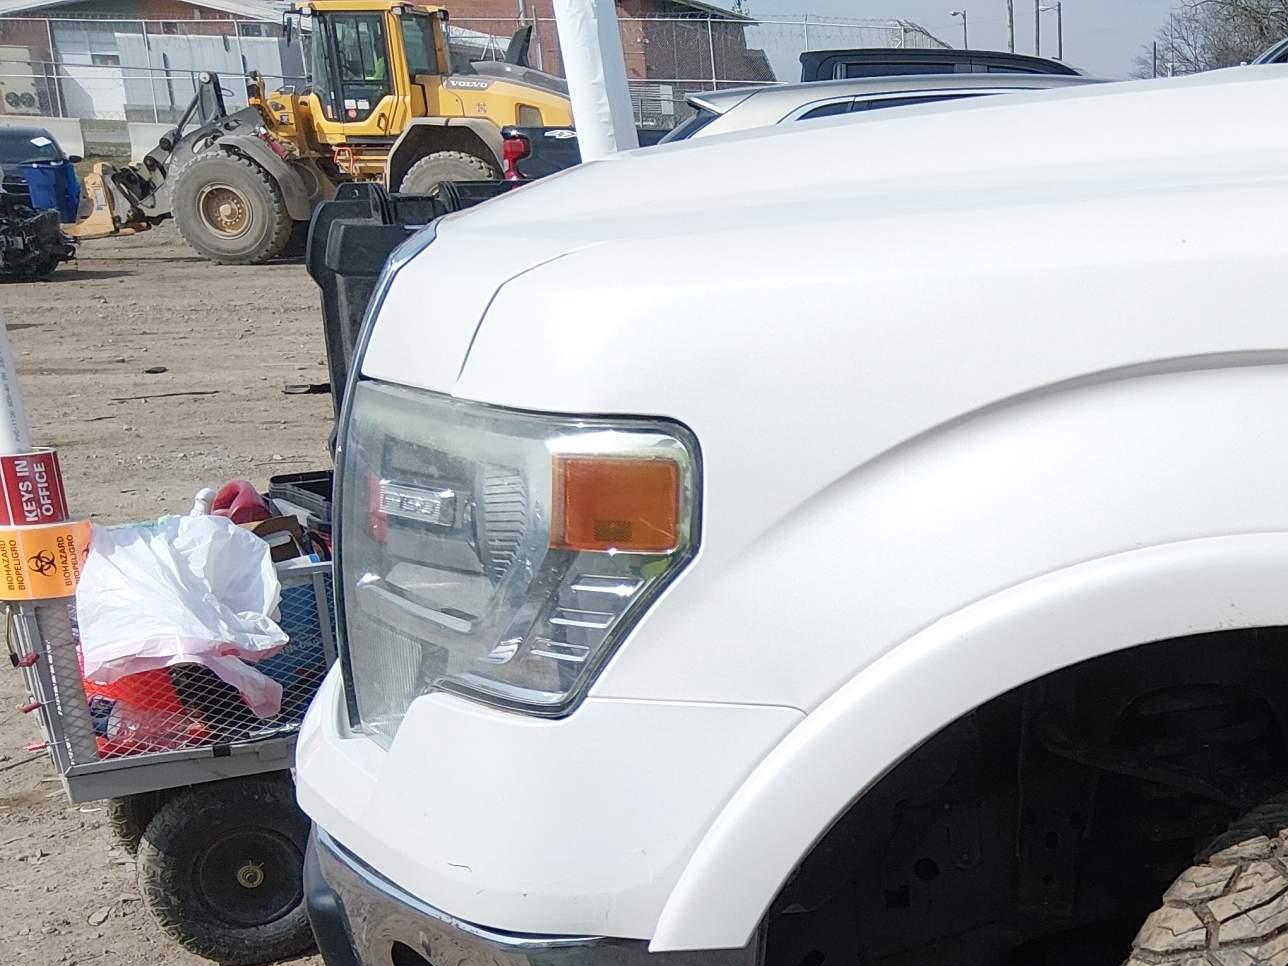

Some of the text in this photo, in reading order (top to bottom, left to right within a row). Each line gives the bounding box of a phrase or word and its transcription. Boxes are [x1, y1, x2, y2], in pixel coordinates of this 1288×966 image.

[450, 80, 488, 88] VOLVO
[14, 460, 39, 522] KEYS IN
[33, 462, 54, 516] OFFICE
[8, 539, 26, 591] BIOPELIGRO
[56, 536, 73, 587] BIOHAZARD
